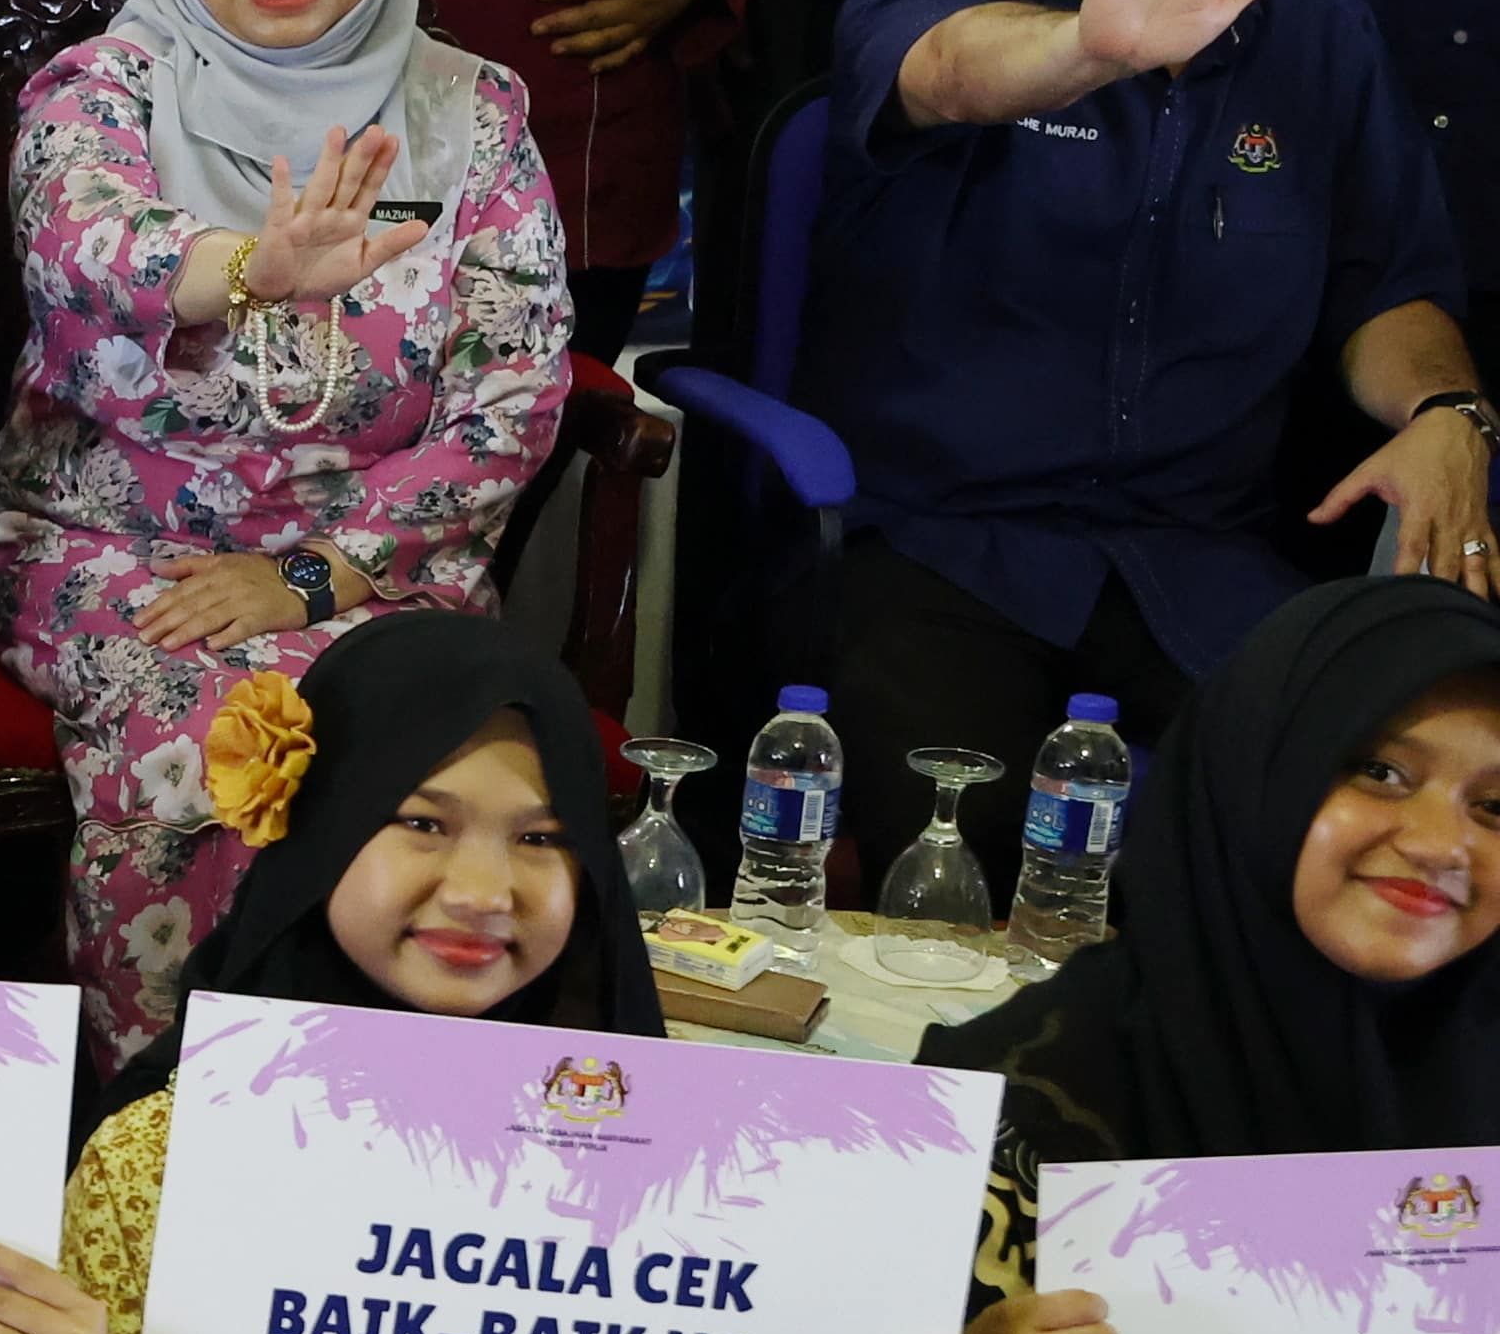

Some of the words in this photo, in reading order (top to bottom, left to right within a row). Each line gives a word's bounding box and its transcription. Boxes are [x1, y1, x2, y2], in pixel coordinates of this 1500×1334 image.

[1046, 123, 1098, 141] MURAD
[356, 1223, 619, 1298] JAGALA
[631, 1251, 759, 1313] CEK
